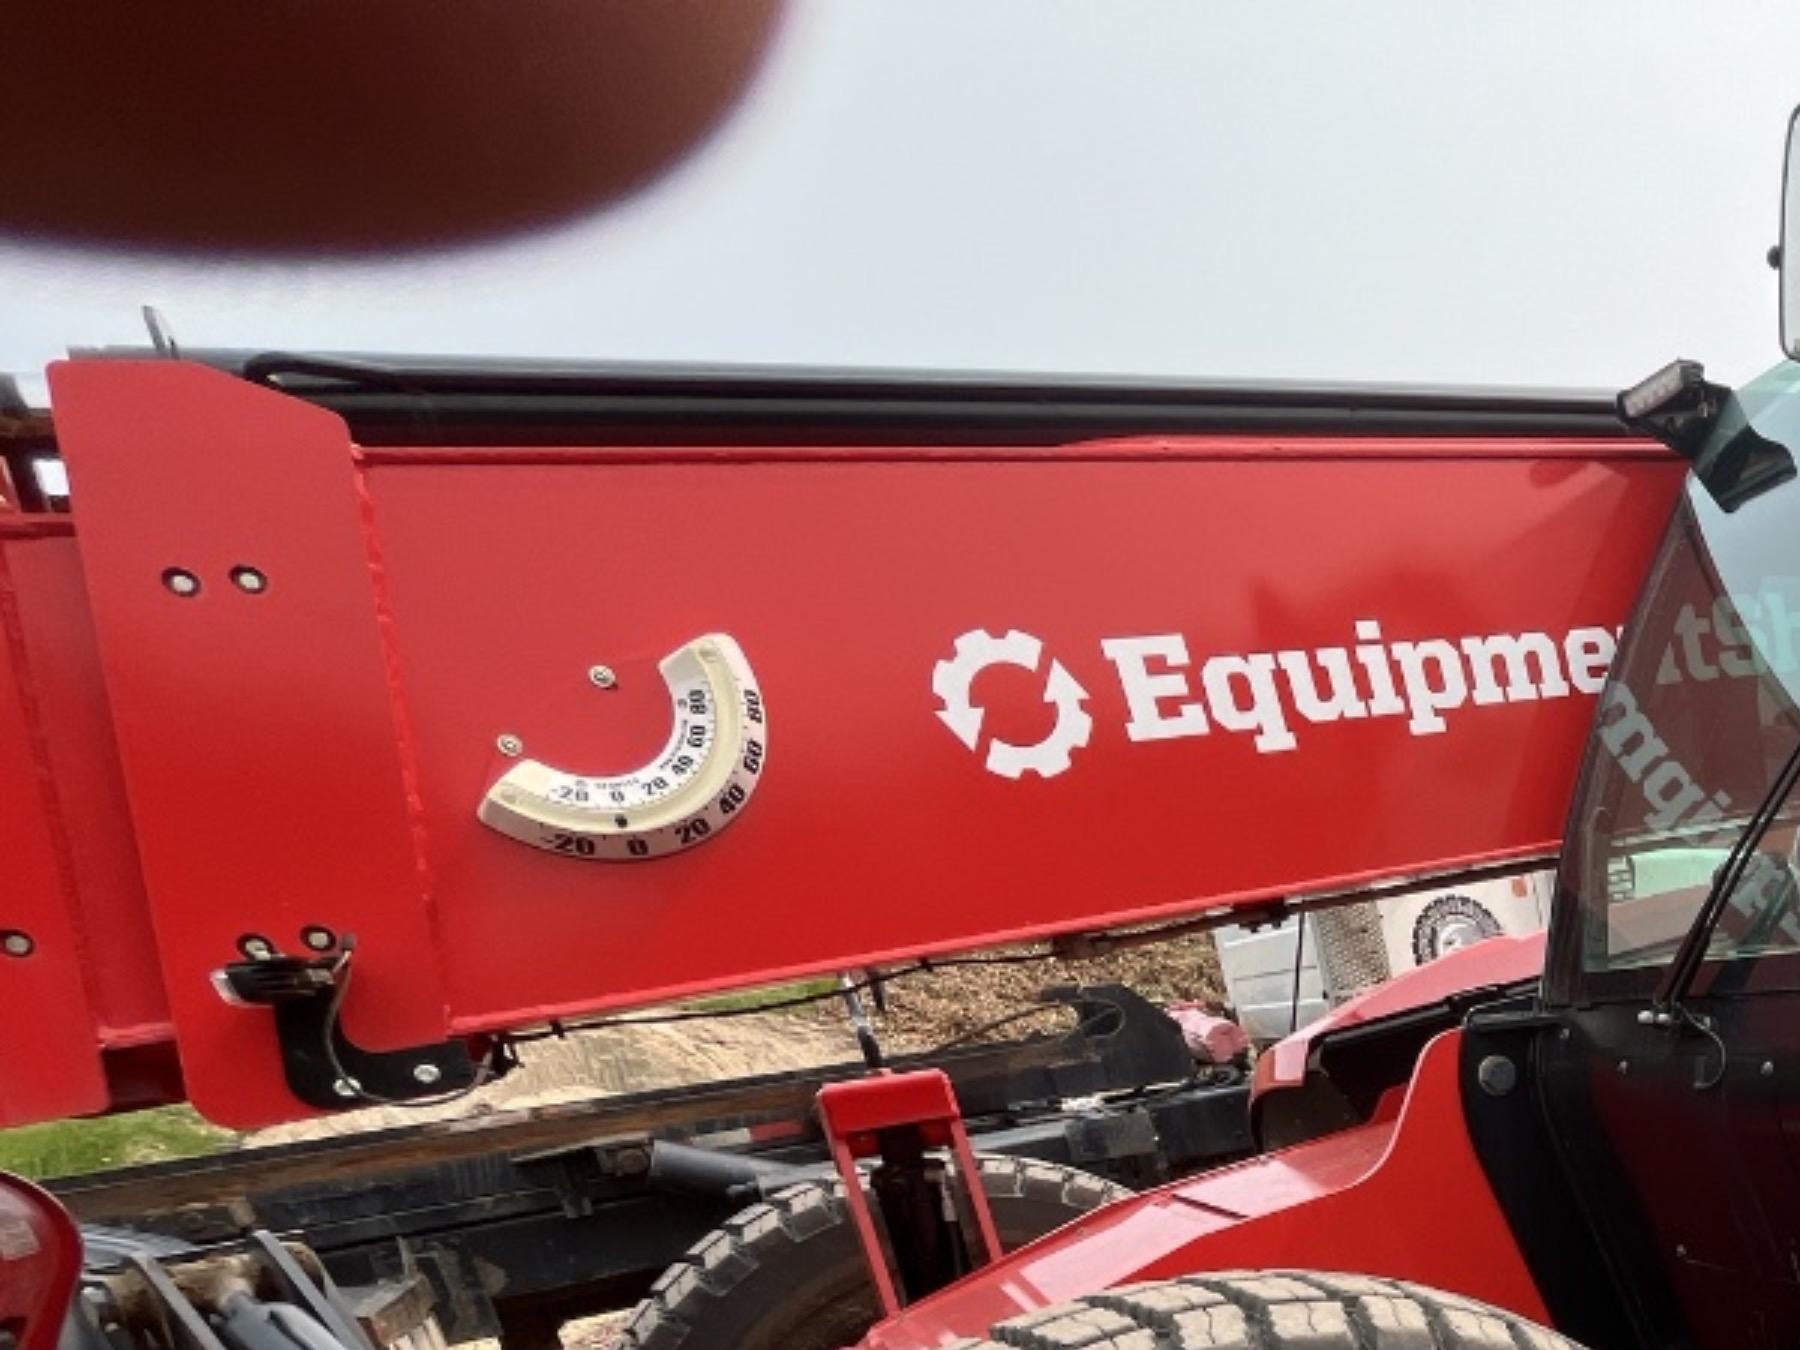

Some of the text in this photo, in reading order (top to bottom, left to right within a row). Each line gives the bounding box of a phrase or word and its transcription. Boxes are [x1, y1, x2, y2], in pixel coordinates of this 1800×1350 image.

[689, 689, 706, 715] 80
[743, 689, 763, 724] 80
[687, 725, 706, 748] 60
[743, 740, 763, 774] 60
[718, 784, 746, 815] 40
[674, 817, 711, 845] 20
[627, 837, 649, 856] 0
